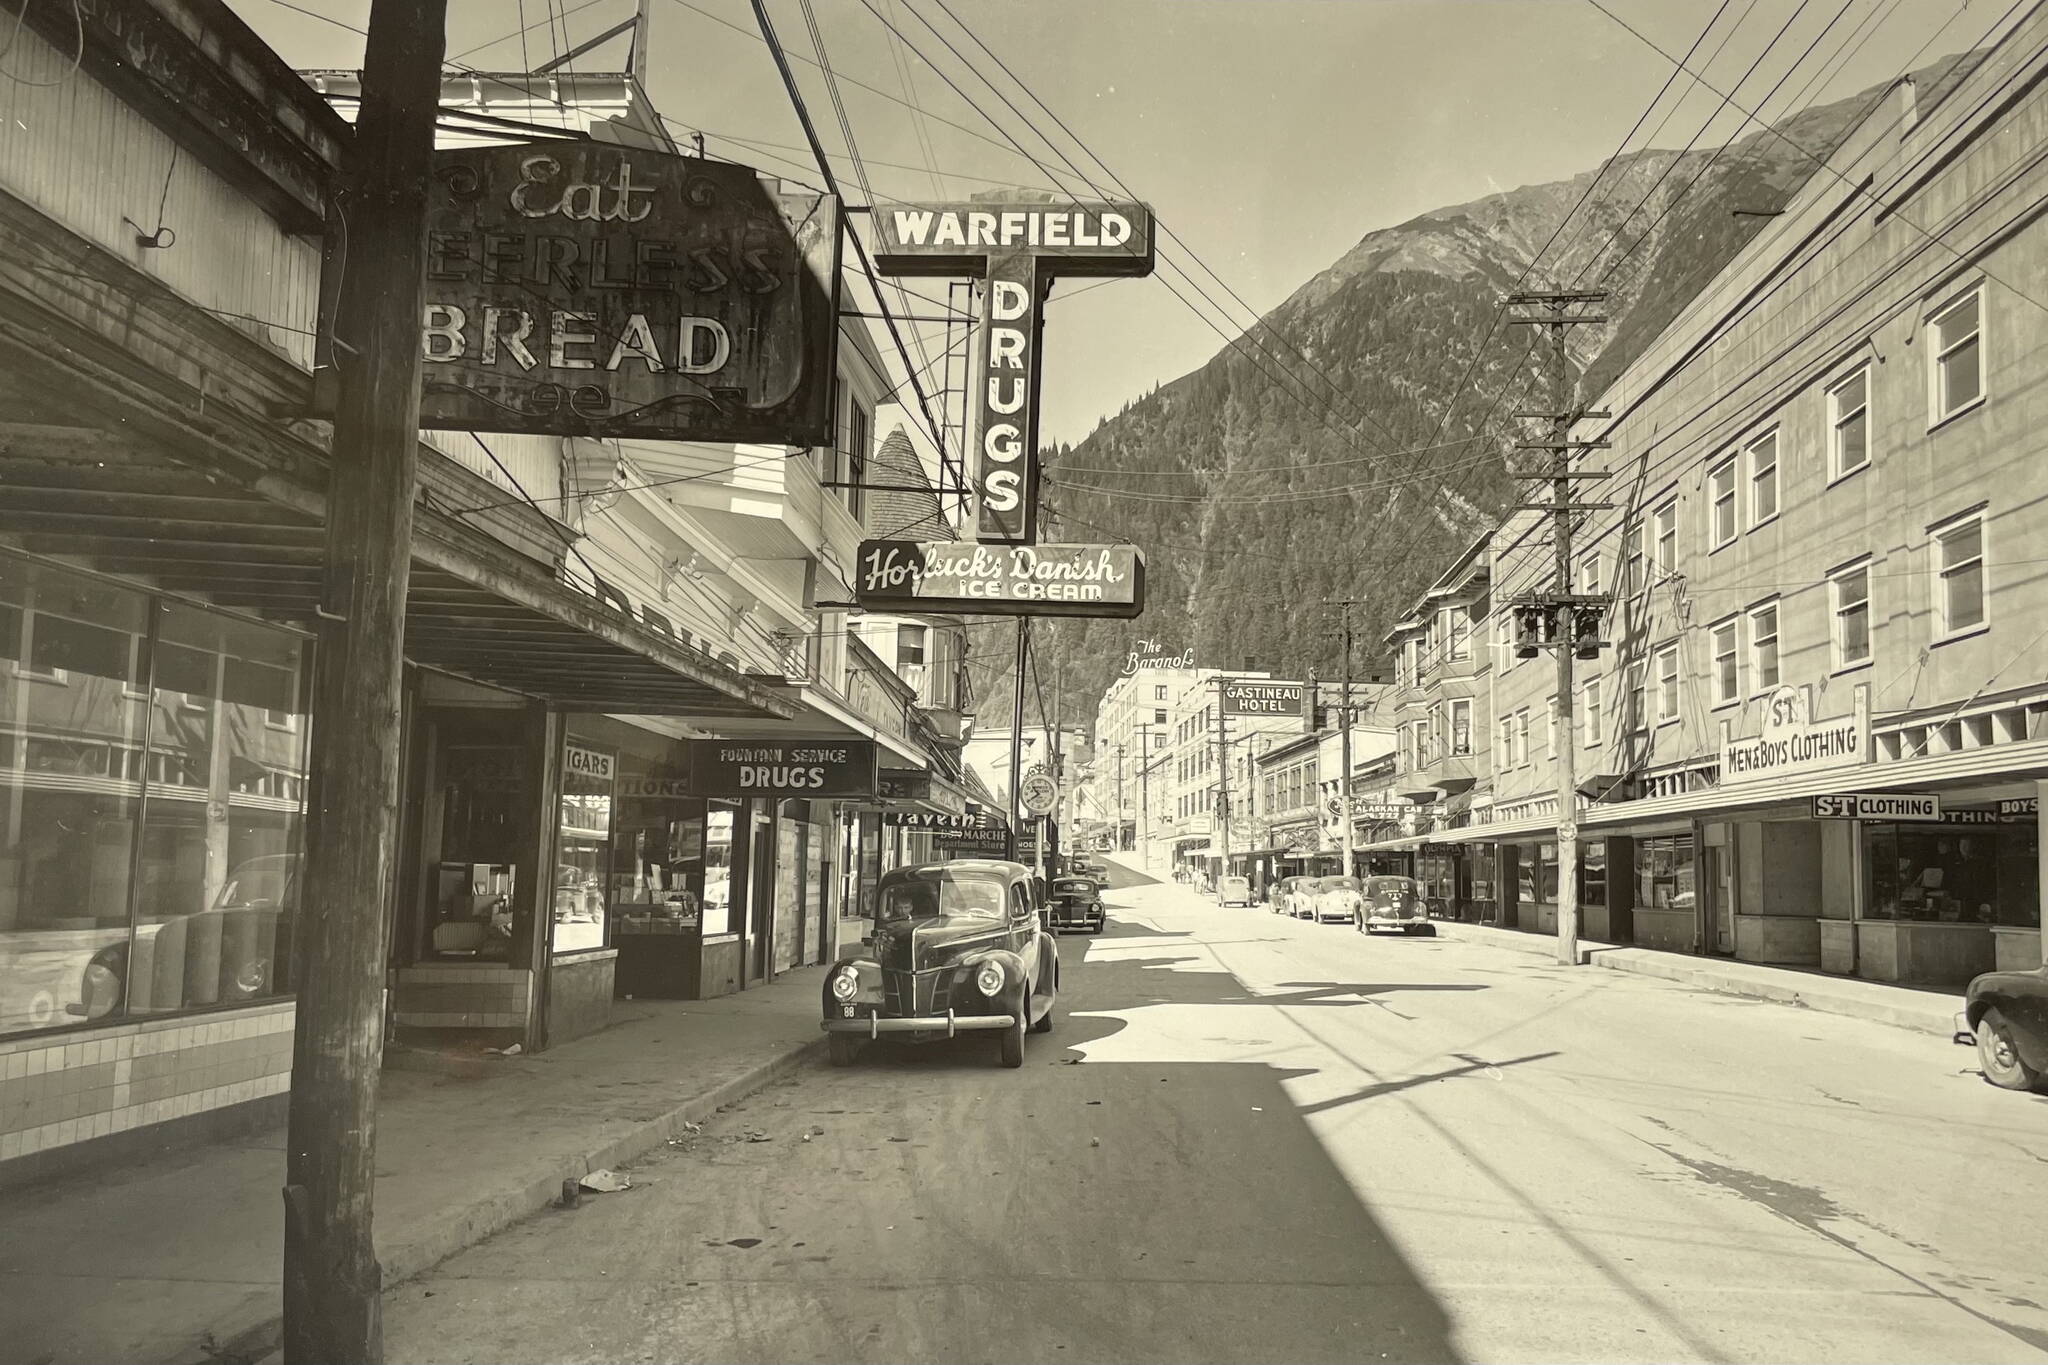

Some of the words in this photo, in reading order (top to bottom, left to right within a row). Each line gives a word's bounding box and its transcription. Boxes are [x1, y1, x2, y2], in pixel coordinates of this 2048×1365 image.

[511, 153, 657, 222] Eat
[894, 211, 1132, 248] WARFIELD
[428, 230, 783, 295] EERLESS
[422, 303, 731, 374] BREAD
[983, 280, 1030, 512] DRUGS
[865, 546, 1001, 591] Horluck's
[1009, 546, 1125, 584] Danish
[959, 580, 1000, 598] ICE
[1012, 583, 1103, 600] CREAM
[1137, 638, 1162, 653] The
[1121, 648, 1194, 675] Baranof
[1226, 687, 1301, 701] GASTINEAU
[1238, 700, 1286, 712] HOTEL
[1791, 726, 1857, 762] CLOTHING
[567, 749, 609, 776] IGARS
[720, 748, 782, 762] FOUNTAIN
[791, 749, 847, 763] SERVICE
[740, 766, 825, 788] DRUGS
[1355, 805, 1399, 814] ALASKAN
[1860, 799, 1933, 816] CLOTHING
[964, 830, 1007, 841] MARCHE
[844, 1006, 854, 1017] 88
